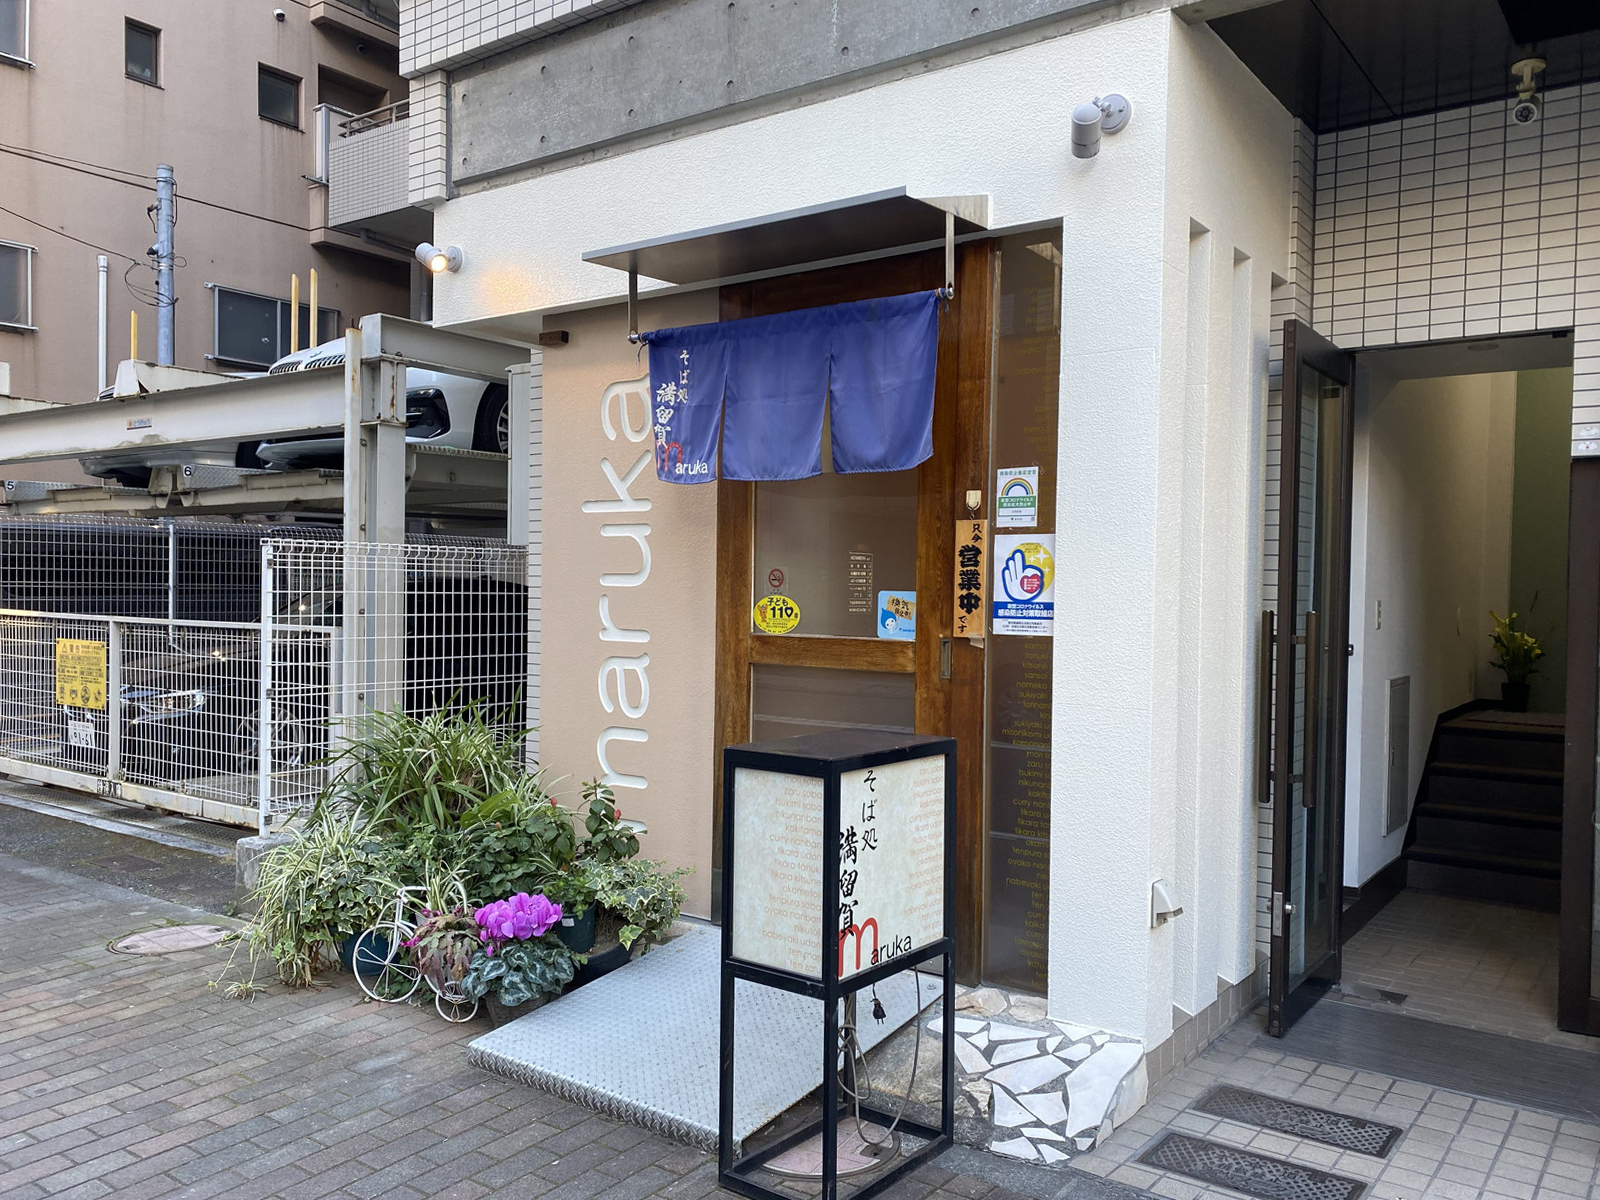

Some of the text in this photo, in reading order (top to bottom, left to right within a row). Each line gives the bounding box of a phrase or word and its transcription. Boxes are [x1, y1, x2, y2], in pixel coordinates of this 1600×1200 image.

[676, 349, 690, 404] そば処
[654, 381, 677, 449] 満留賀
[184, 466, 192, 477] 6
[7, 481, 14, 490] 5
[971, 523, 982, 543] 只今
[958, 544, 982, 615] 営業中
[767, 597, 788, 606] 子ども
[891, 597, 909, 611] 換気
[958, 615, 967, 633] です
[785, 788, 822, 799] zaru soba
[802, 801, 822, 811] soba
[861, 769, 878, 851] そば処
[785, 822, 822, 837] kakitama
[770, 834, 822, 849] curry nanban
[801, 850, 821, 861] udon
[839, 825, 859, 940] 満留賀
[768, 893, 821, 912] tenpura soba
[764, 906, 821, 924] oyako nanban
[763, 929, 821, 949] nabeyaki udon
[789, 947, 801, 956] ten
[790, 959, 803, 969] ten
